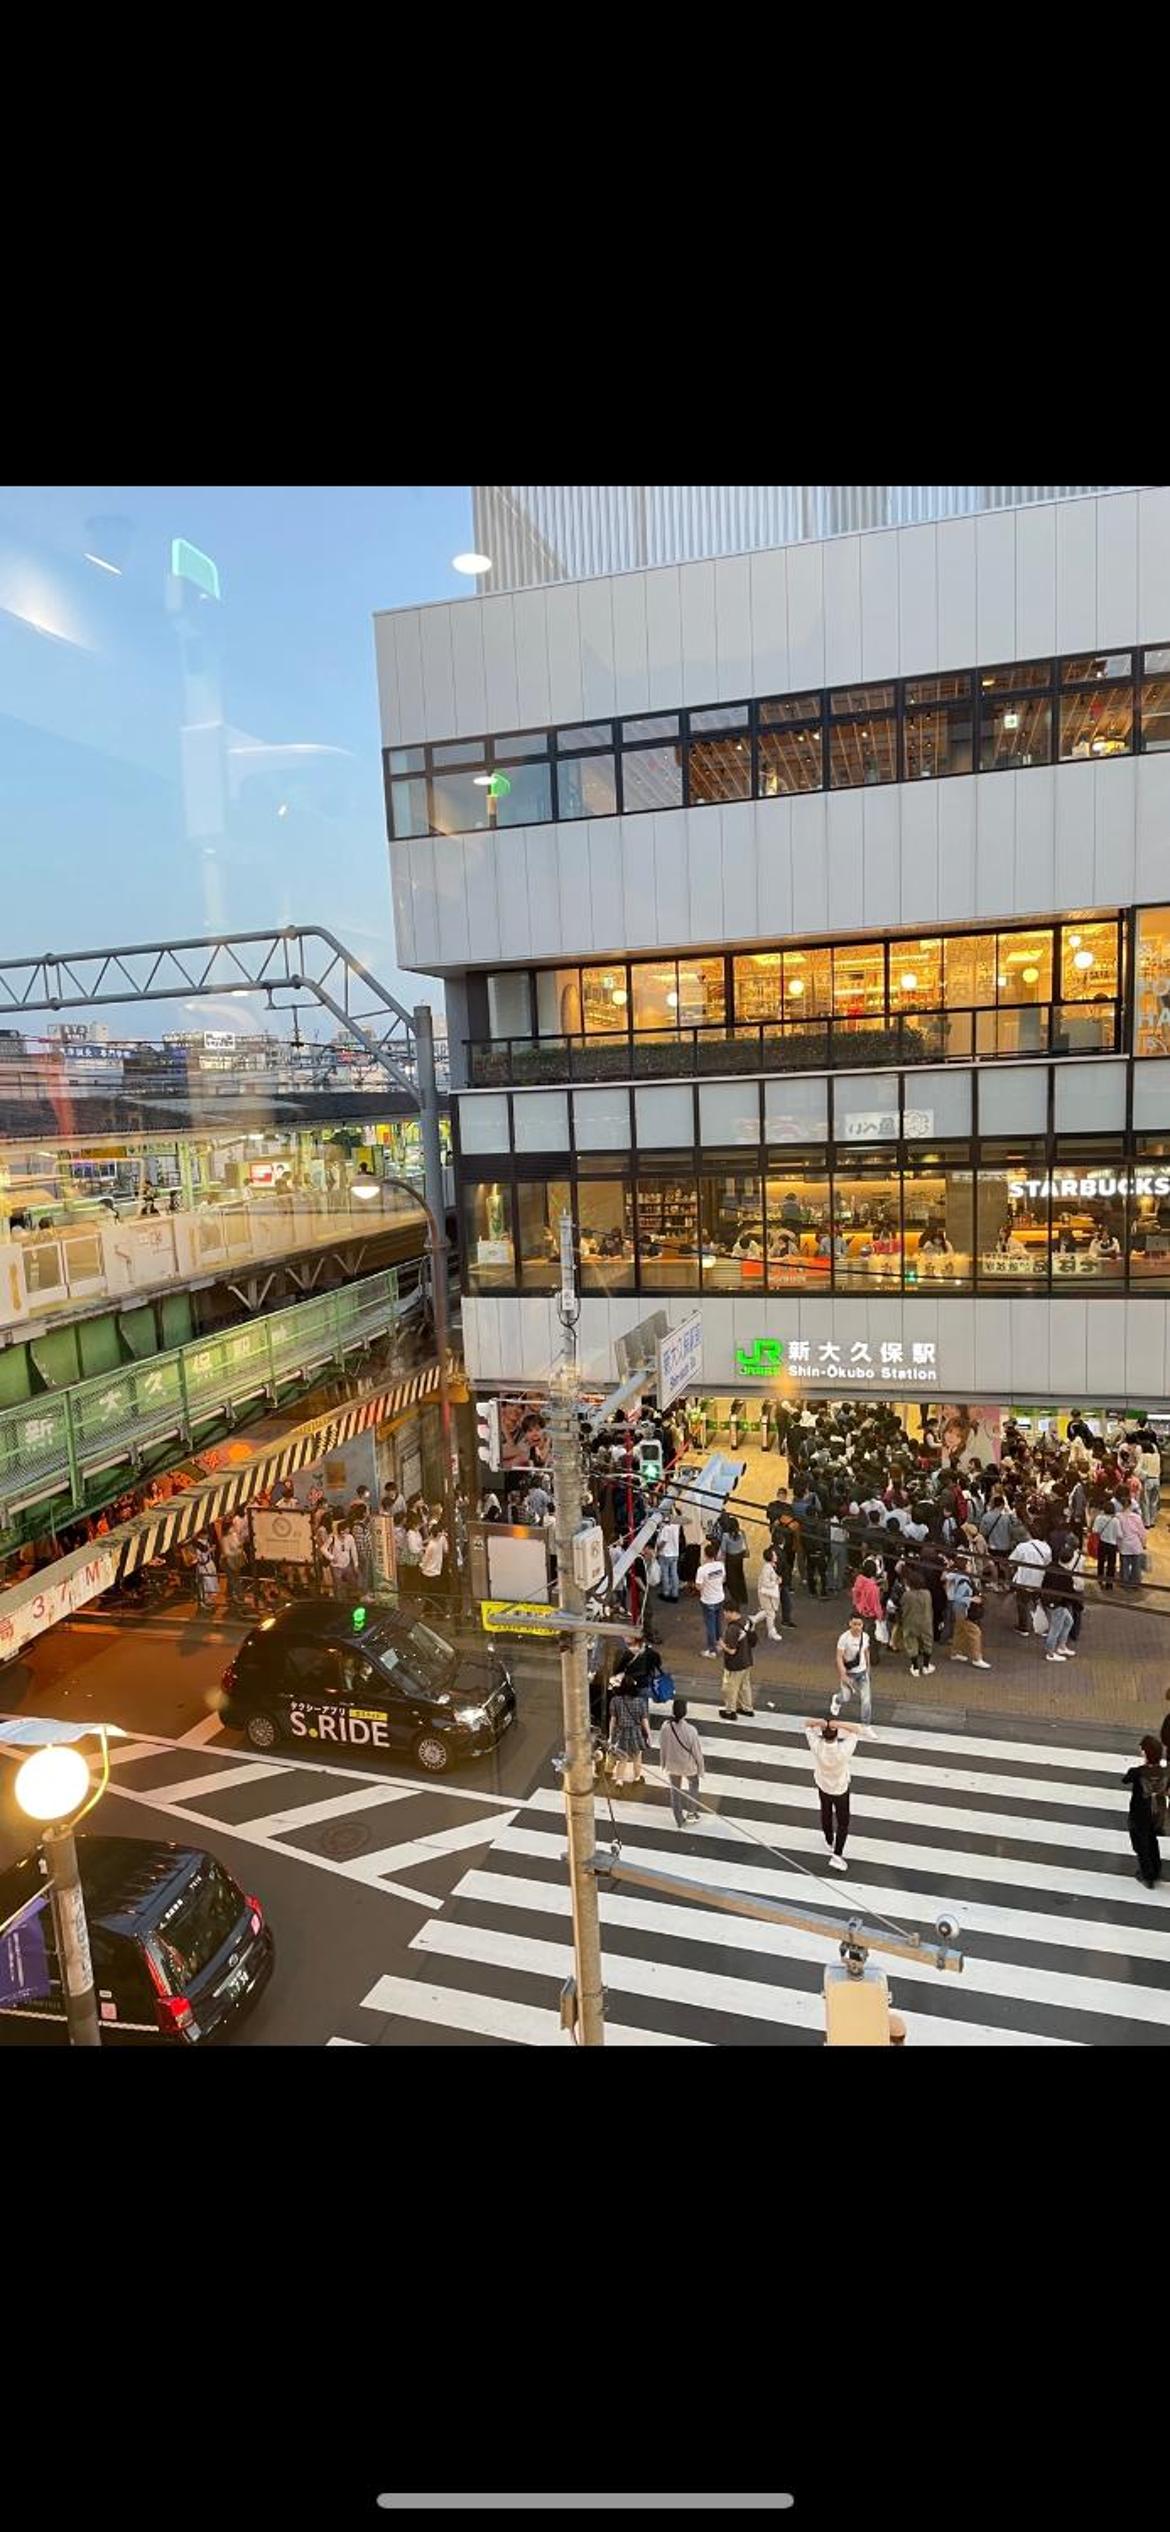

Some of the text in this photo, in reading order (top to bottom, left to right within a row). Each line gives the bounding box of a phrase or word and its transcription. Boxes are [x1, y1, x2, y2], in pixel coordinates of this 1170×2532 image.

[1008, 1178, 1170, 1198] STARBUCKS
[736, 1338, 783, 1365] JR
[788, 1341, 936, 1363] 新大久保駅
[881, 1367, 937, 1380] Station
[290, 1701, 346, 1716] タクシーアプリ
[290, 1711, 390, 1747] S.RIDE
